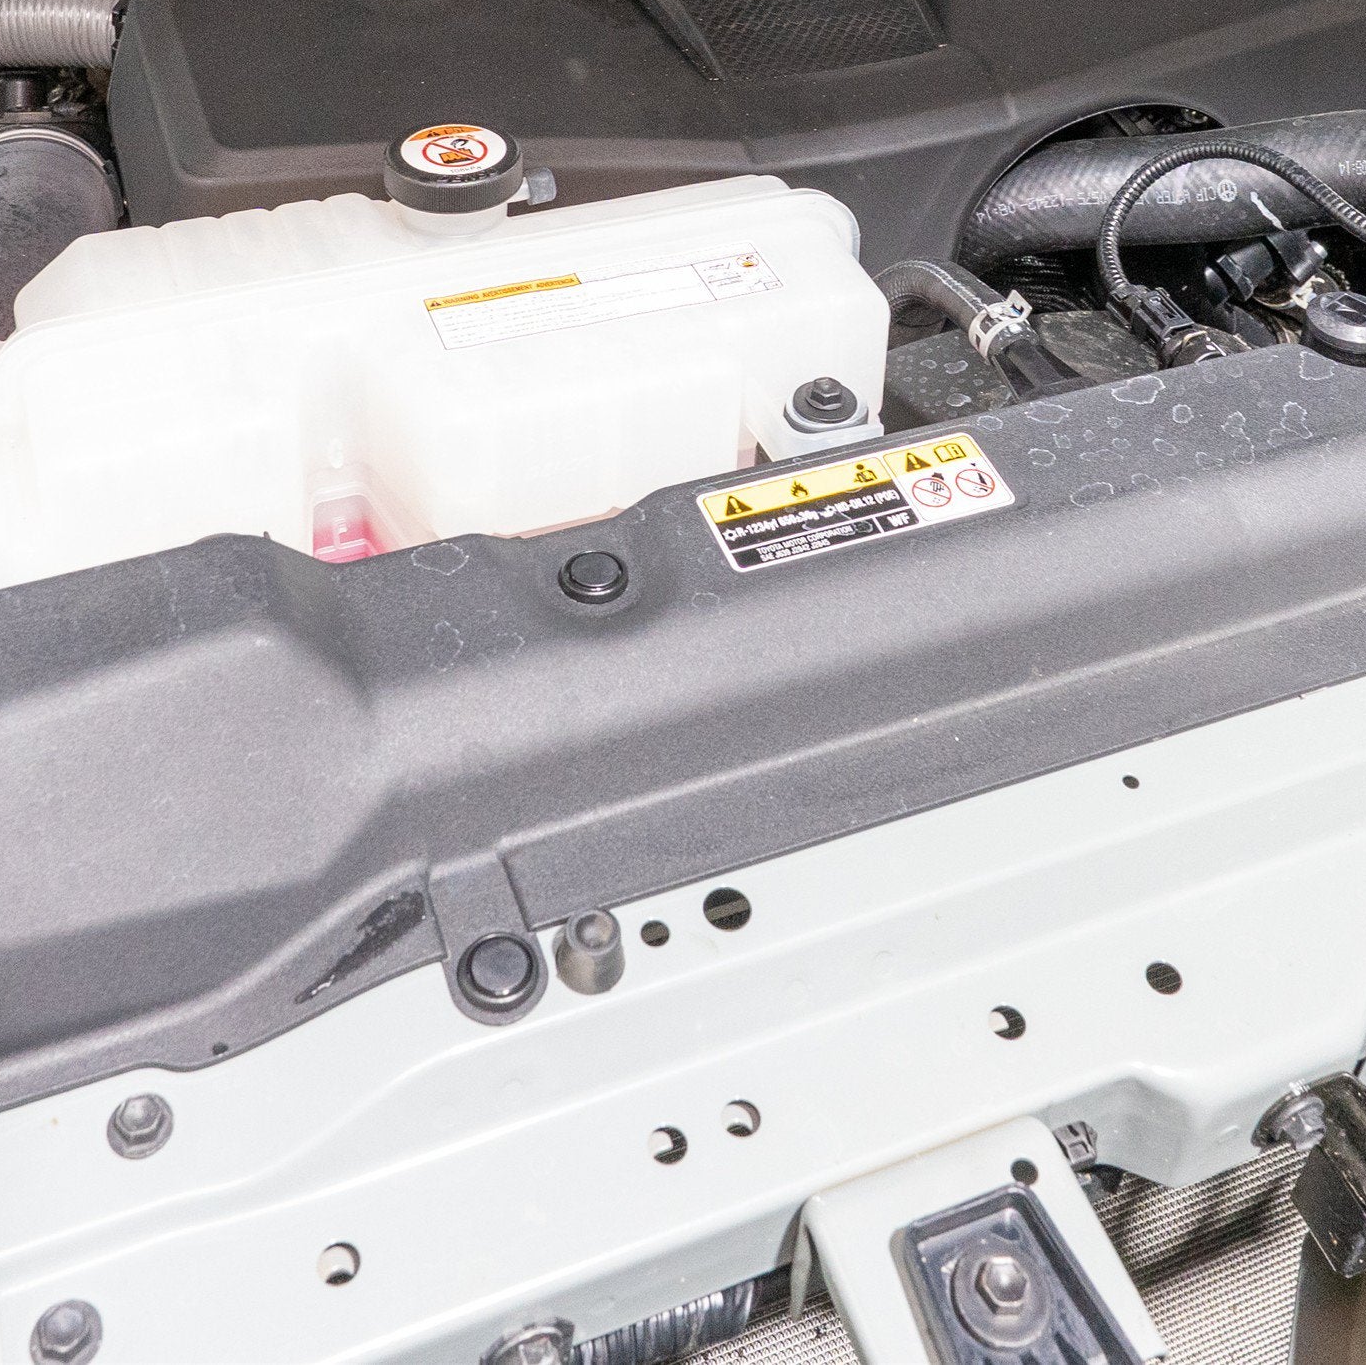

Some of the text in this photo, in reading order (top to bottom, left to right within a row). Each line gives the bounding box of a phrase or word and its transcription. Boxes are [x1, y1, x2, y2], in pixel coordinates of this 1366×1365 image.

[443, 294, 480, 305] WARNING
[874, 489, 901, 504] (POE)
[887, 512, 910, 527] WF
[756, 525, 854, 554] TOYOTA MOTOR CORPORATION
[760, 553, 775, 562] SAE
